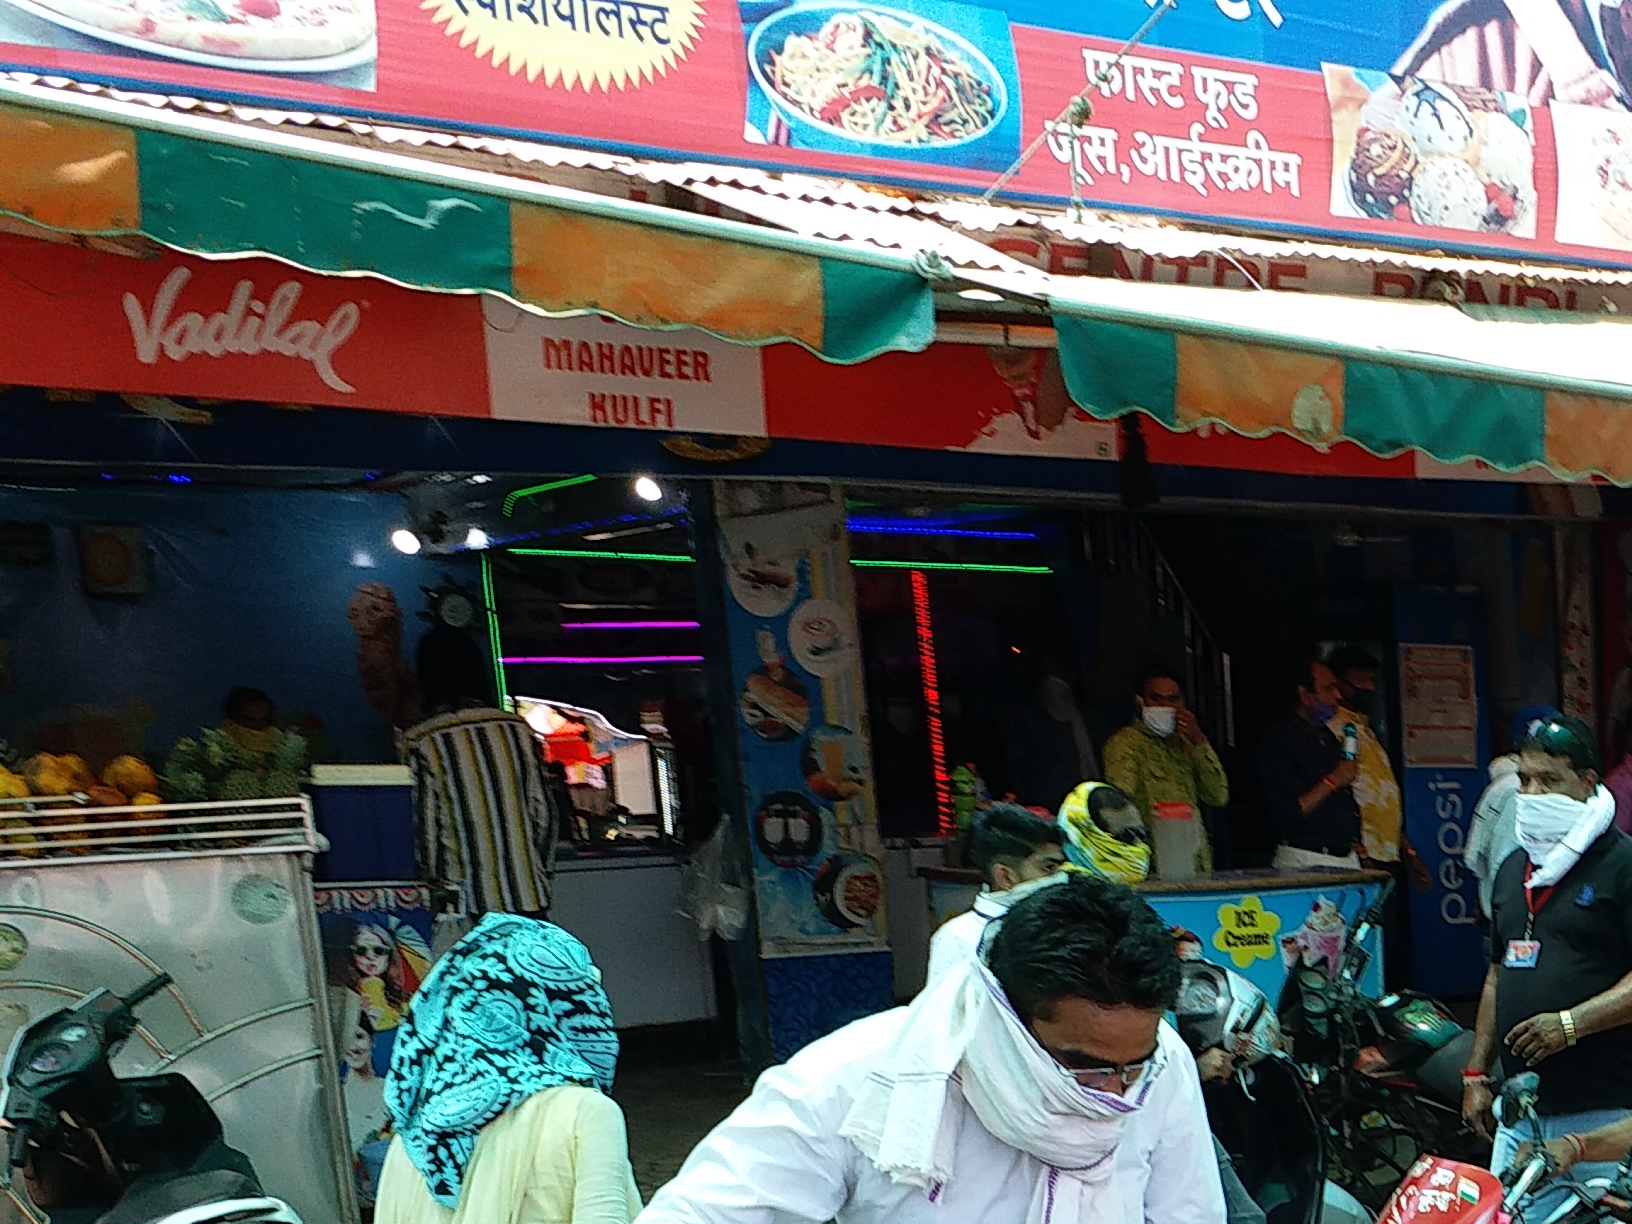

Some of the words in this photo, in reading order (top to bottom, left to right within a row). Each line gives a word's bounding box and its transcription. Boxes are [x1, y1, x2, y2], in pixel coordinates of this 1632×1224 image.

[1081, 48, 1186, 109] फास्ट
[1190, 65, 1259, 129] फूड
[122, 265, 361, 394] Vadilal
[541, 336, 713, 383] MAHAVEER
[588, 390, 675, 429] KULFI
[1428, 779, 1476, 925] pepsi
